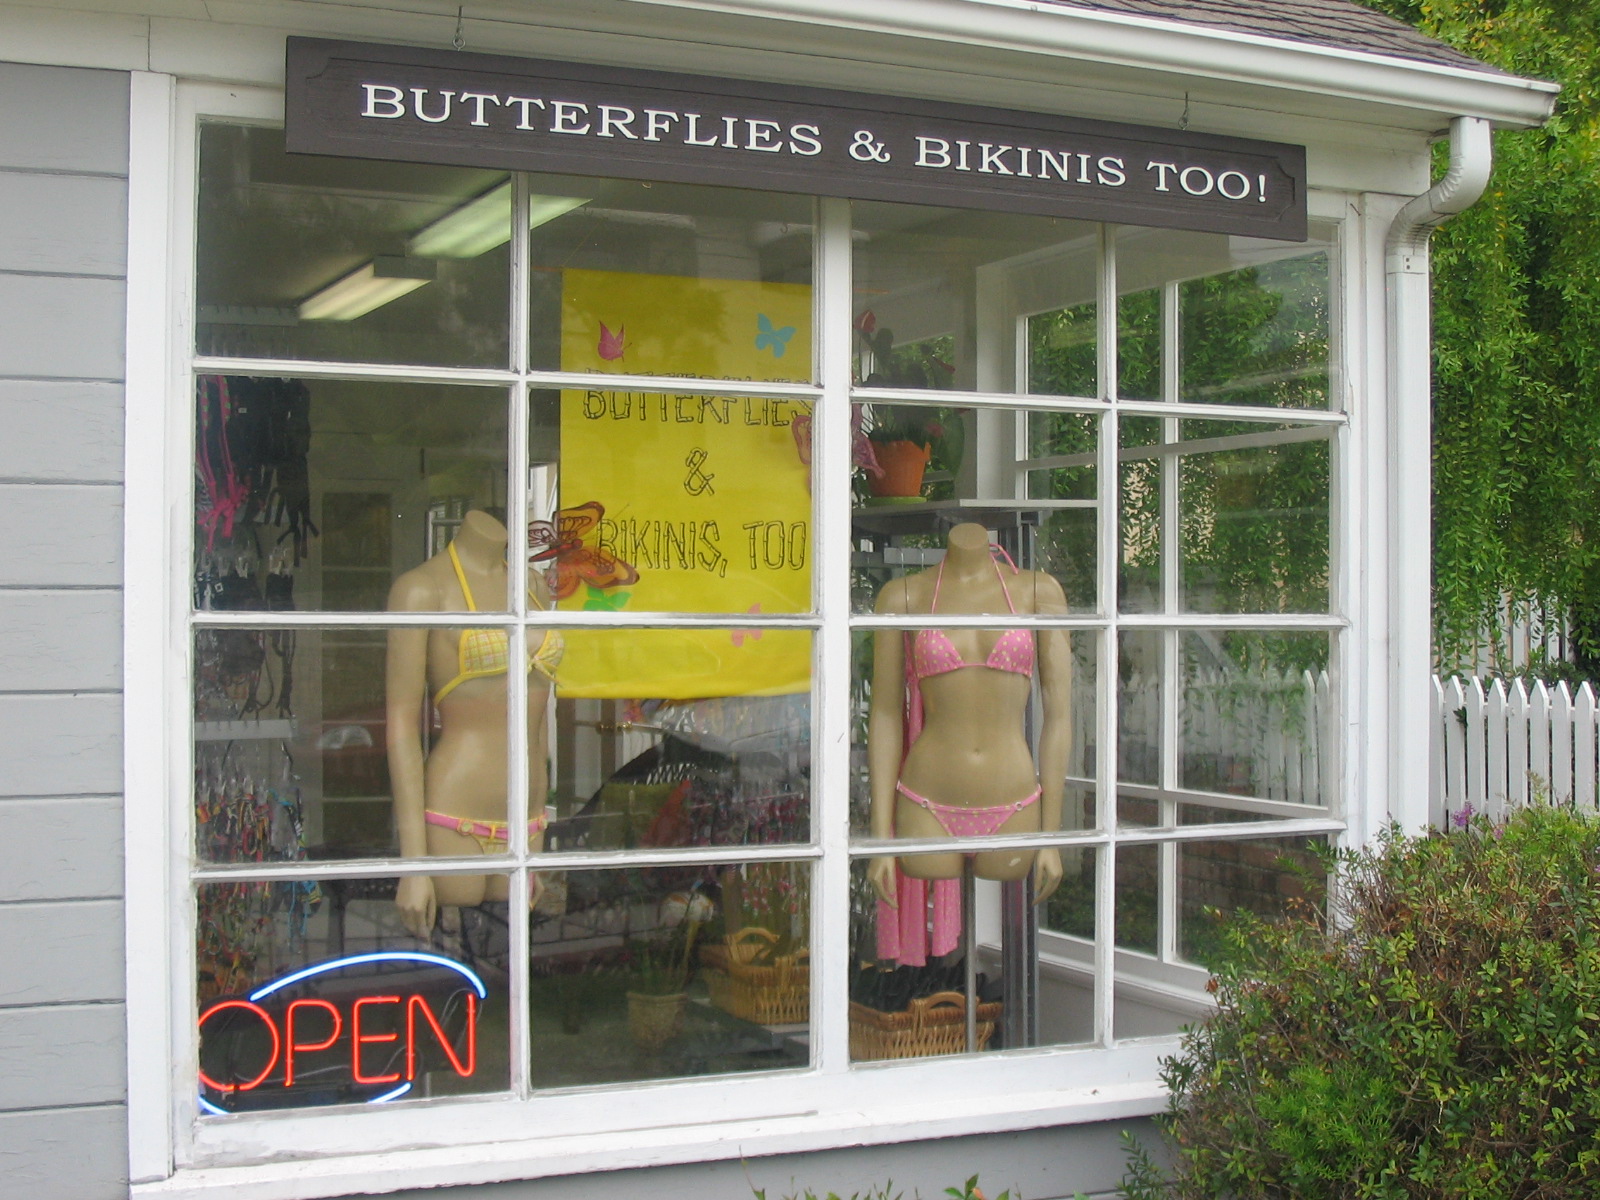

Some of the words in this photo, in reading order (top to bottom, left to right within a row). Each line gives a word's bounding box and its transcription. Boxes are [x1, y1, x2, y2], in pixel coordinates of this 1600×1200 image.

[361, 84, 822, 157] BUTTERFLIES
[848, 130, 890, 163] &
[915, 136, 1127, 187] BIKINIS
[1146, 161, 1267, 203] TOO!
[684, 447, 715, 496] &
[743, 520, 807, 570] TOO
[198, 994, 476, 1092] OPEN
